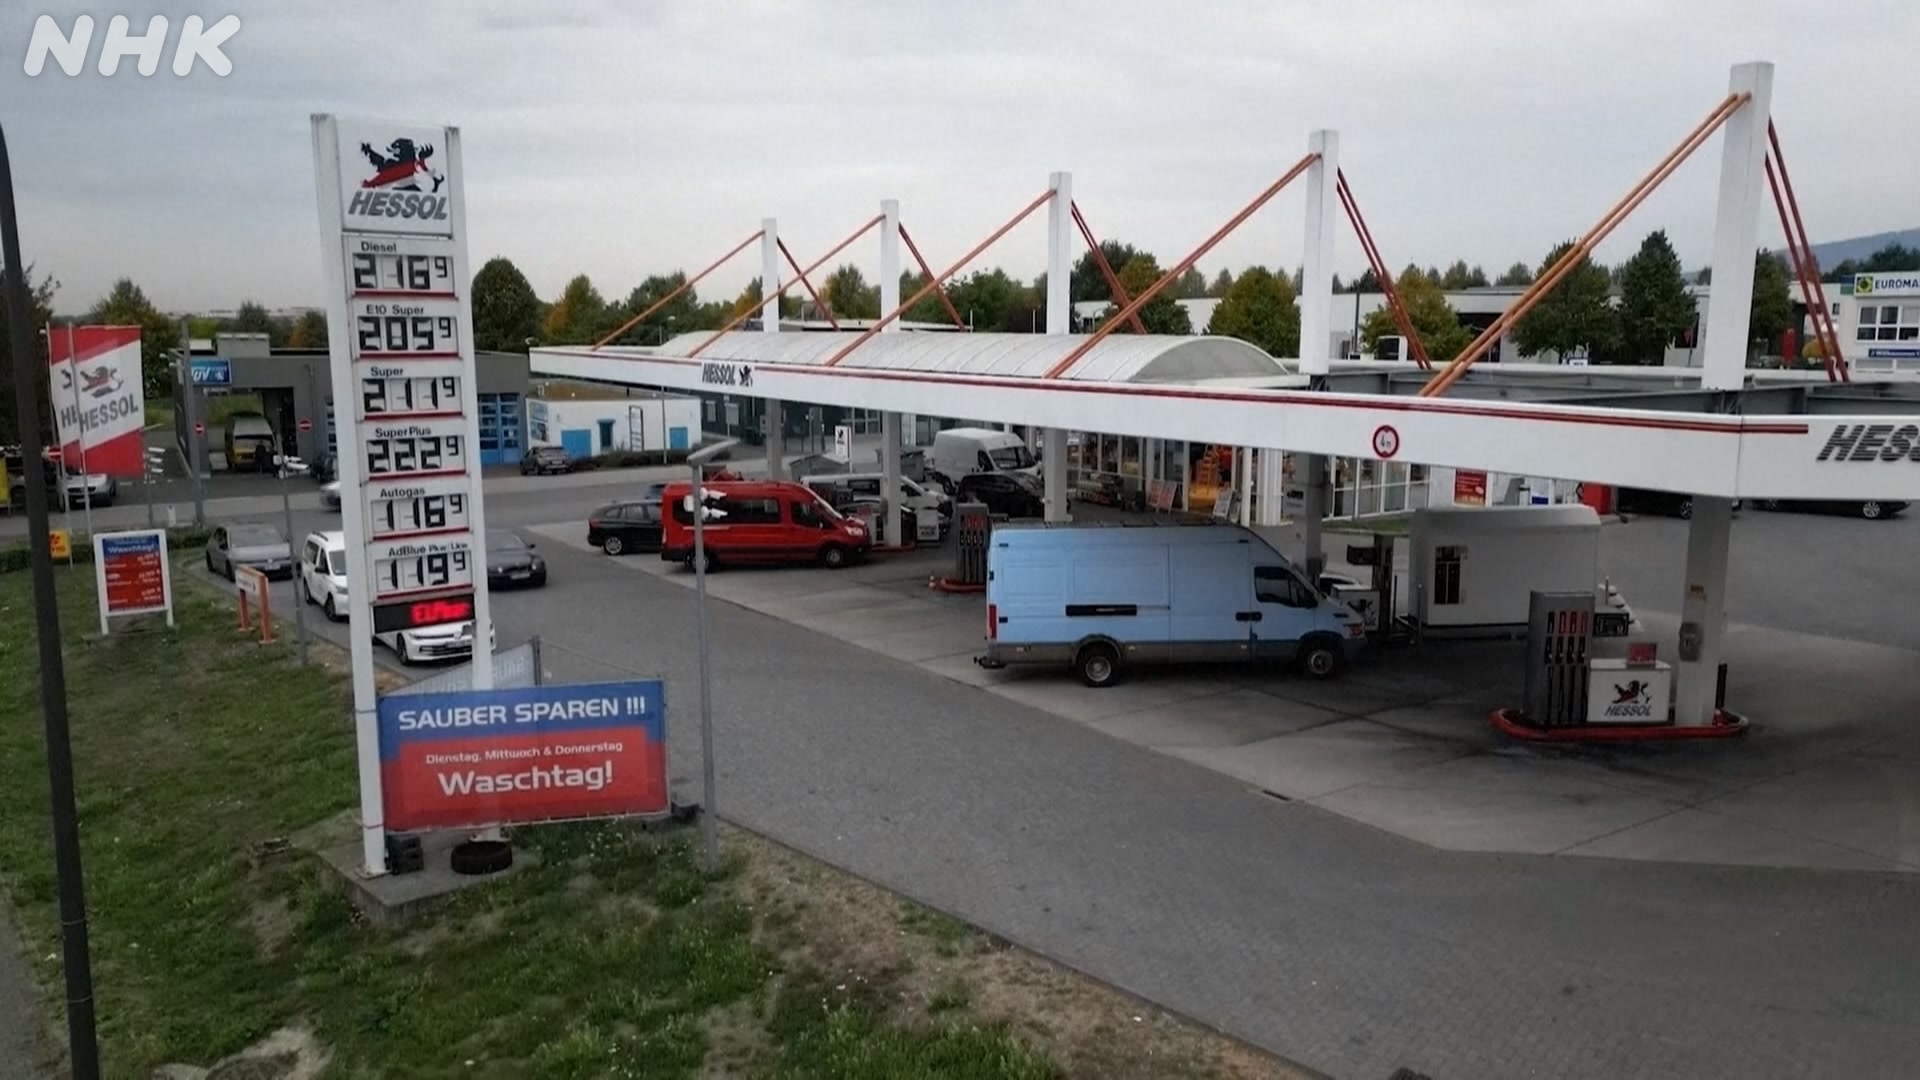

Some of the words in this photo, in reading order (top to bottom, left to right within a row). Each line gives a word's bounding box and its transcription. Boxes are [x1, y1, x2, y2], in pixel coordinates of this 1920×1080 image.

[348, 190, 448, 220] HESSOL
[361, 241, 396, 252] Diesel
[366, 305, 387, 314] E10
[392, 305, 424, 317] Super
[371, 367, 404, 378] Super
[702, 363, 736, 385] HESSOL
[80, 394, 139, 433] HESSOL
[1816, 424, 1920, 462] HES
[380, 488, 425, 500] Autogas
[388, 546, 426, 557] AdBlue
[399, 704, 507, 731] SAUBER
[514, 698, 620, 723] SPAREN
[1604, 705, 1652, 717] HESSOL
[485, 746, 541, 761] Mittwoch
[544, 747, 552, 756] &
[555, 742, 623, 756] Donnerstag
[437, 760, 613, 796] Waschtag!
